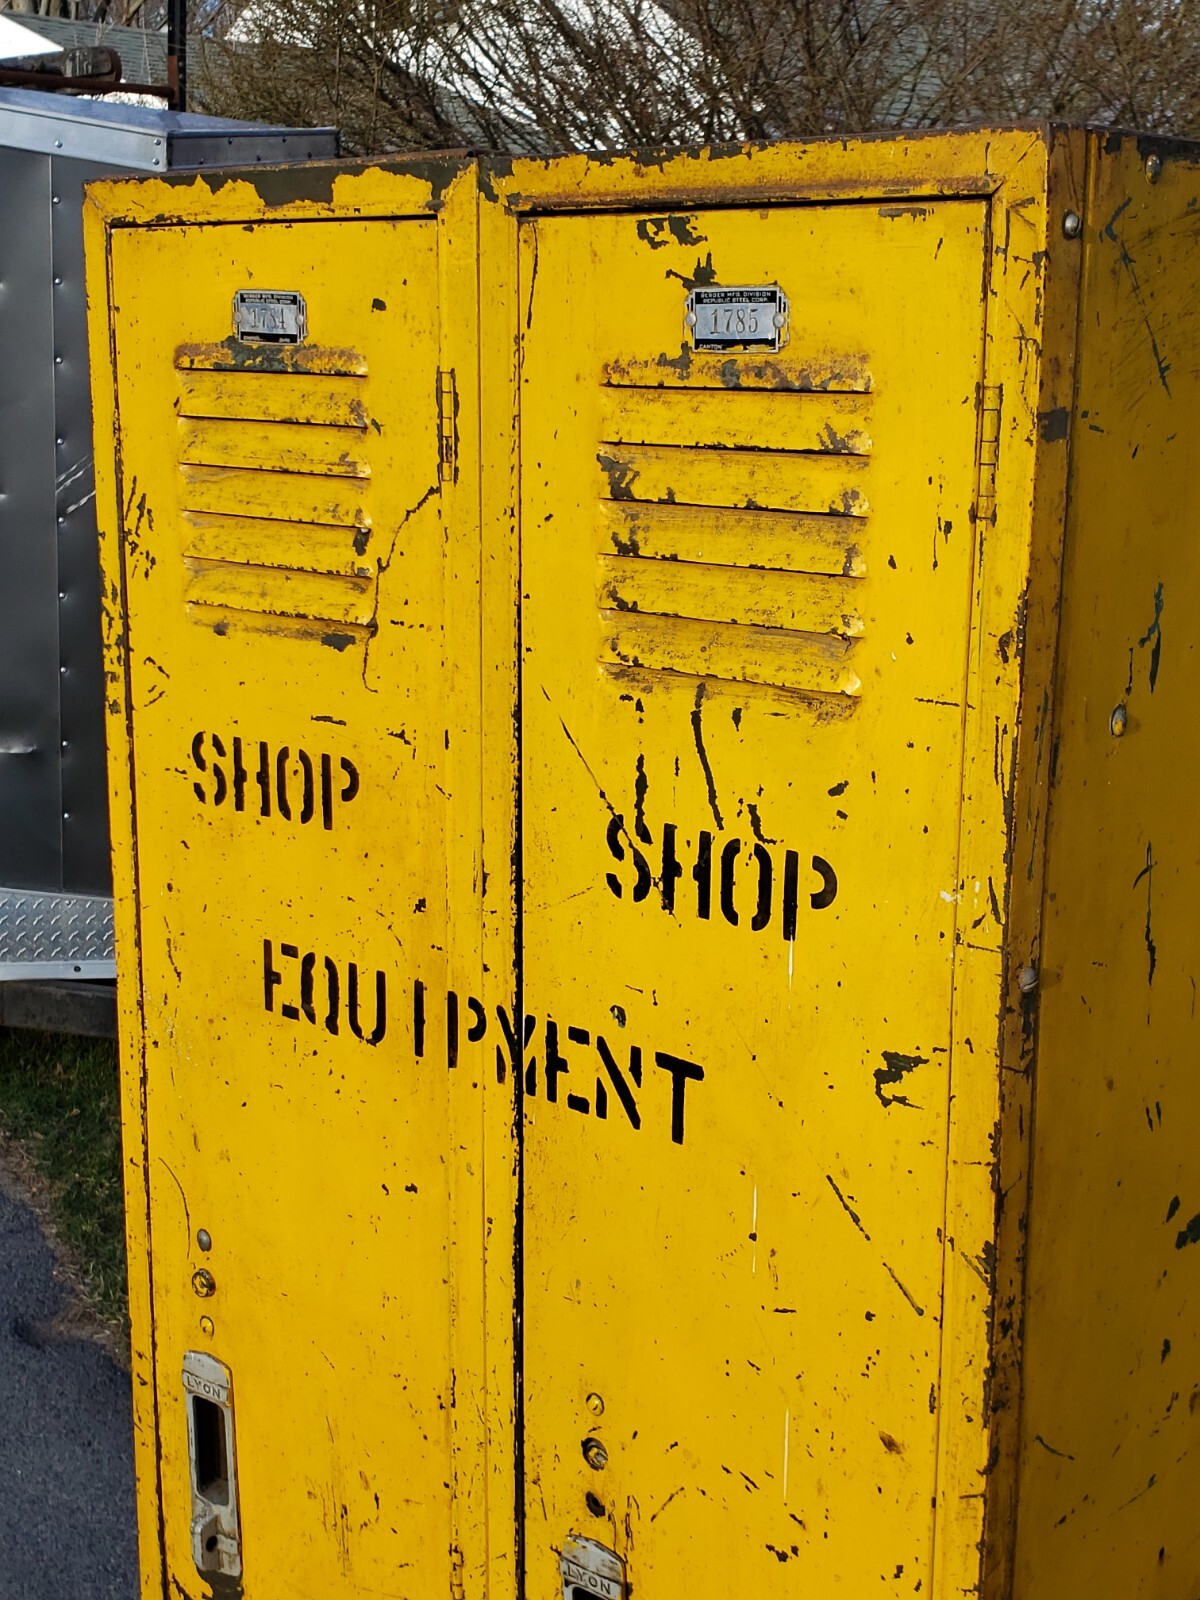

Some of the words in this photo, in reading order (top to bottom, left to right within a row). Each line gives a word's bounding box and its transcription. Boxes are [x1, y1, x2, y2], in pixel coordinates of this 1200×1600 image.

[710, 308, 758, 335] 1785
[191, 730, 360, 831] SHOP
[605, 813, 838, 942] SHOP
[263, 938, 705, 1146] EQUIPMENT
[186, 1374, 221, 1400] LYON
[567, 1563, 611, 1596] LYON
